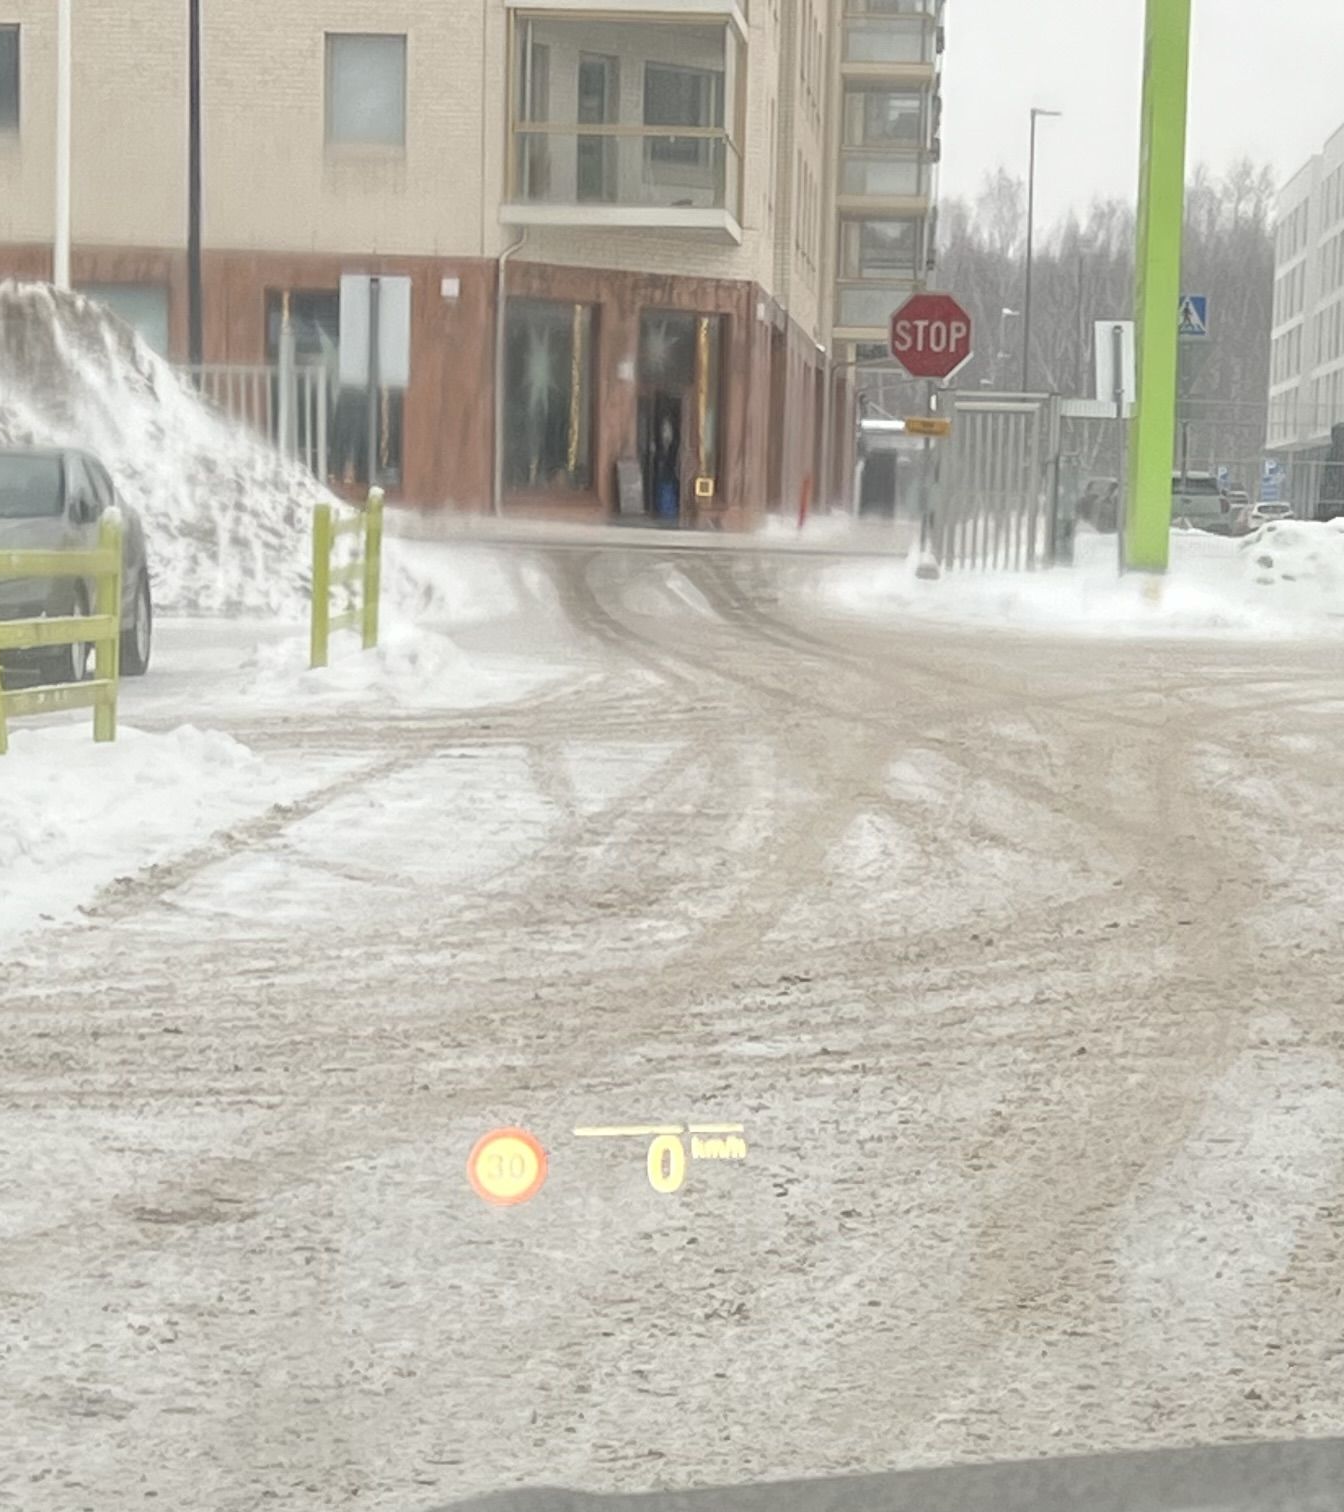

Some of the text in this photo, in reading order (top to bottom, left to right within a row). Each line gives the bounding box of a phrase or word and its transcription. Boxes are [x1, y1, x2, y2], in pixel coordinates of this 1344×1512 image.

[895, 319, 967, 352] STOP
[487, 1152, 525, 1179] 30
[647, 1135, 684, 1193] 0
